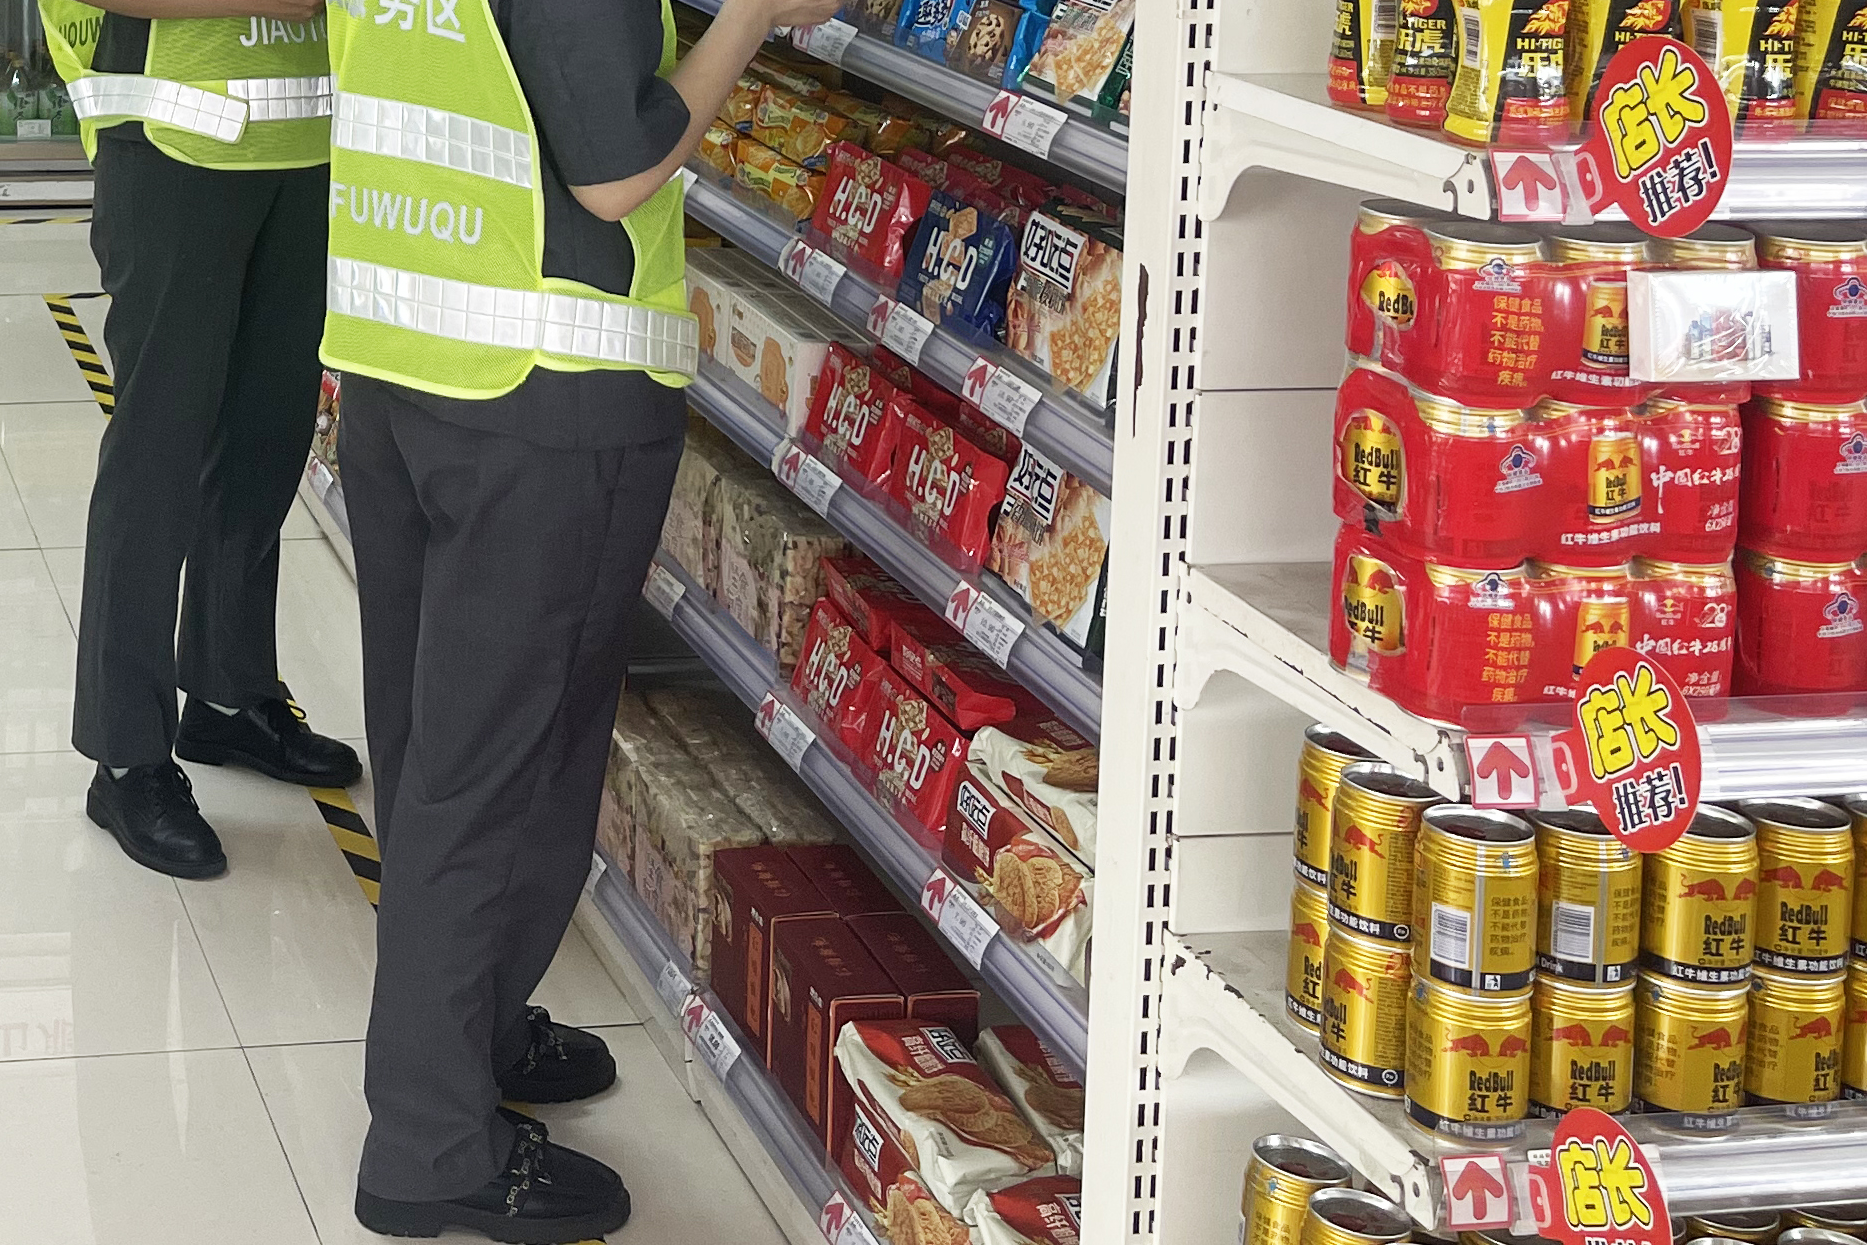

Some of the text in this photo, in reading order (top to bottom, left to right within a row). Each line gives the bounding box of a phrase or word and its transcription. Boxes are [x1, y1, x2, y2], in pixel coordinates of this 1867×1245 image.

[1602, 49, 1708, 179] 店长
[1641, 138, 1718, 225] 推荐!
[330, 181, 483, 245] FUWUQU
[1021, 217, 1082, 285] 好吃点
[1493, 295, 1543, 315] 保健食品
[1489, 331, 1541, 352] 不能代替
[1487, 349, 1538, 370] 药物治疗
[1354, 442, 1400, 470] RedBull
[1353, 467, 1398, 491] 红牛
[1487, 612, 1533, 629] 保健食品
[1484, 648, 1530, 666] 不能代替
[1481, 666, 1529, 684] 药物治疗
[1578, 665, 1677, 779] 店长
[1615, 766, 1687, 835] 推荐!
[1703, 913, 1747, 937] RedBull
[1779, 901, 1828, 926] RedBull
[1702, 936, 1746, 957] 红牛
[1778, 923, 1828, 947] 红牛
[1468, 1070, 1514, 1093] RedBull
[1570, 1059, 1616, 1082] RedBull
[1466, 1092, 1514, 1114] 红牛
[1569, 1081, 1616, 1103] 红牛
[1560, 1138, 1653, 1228] 店长
